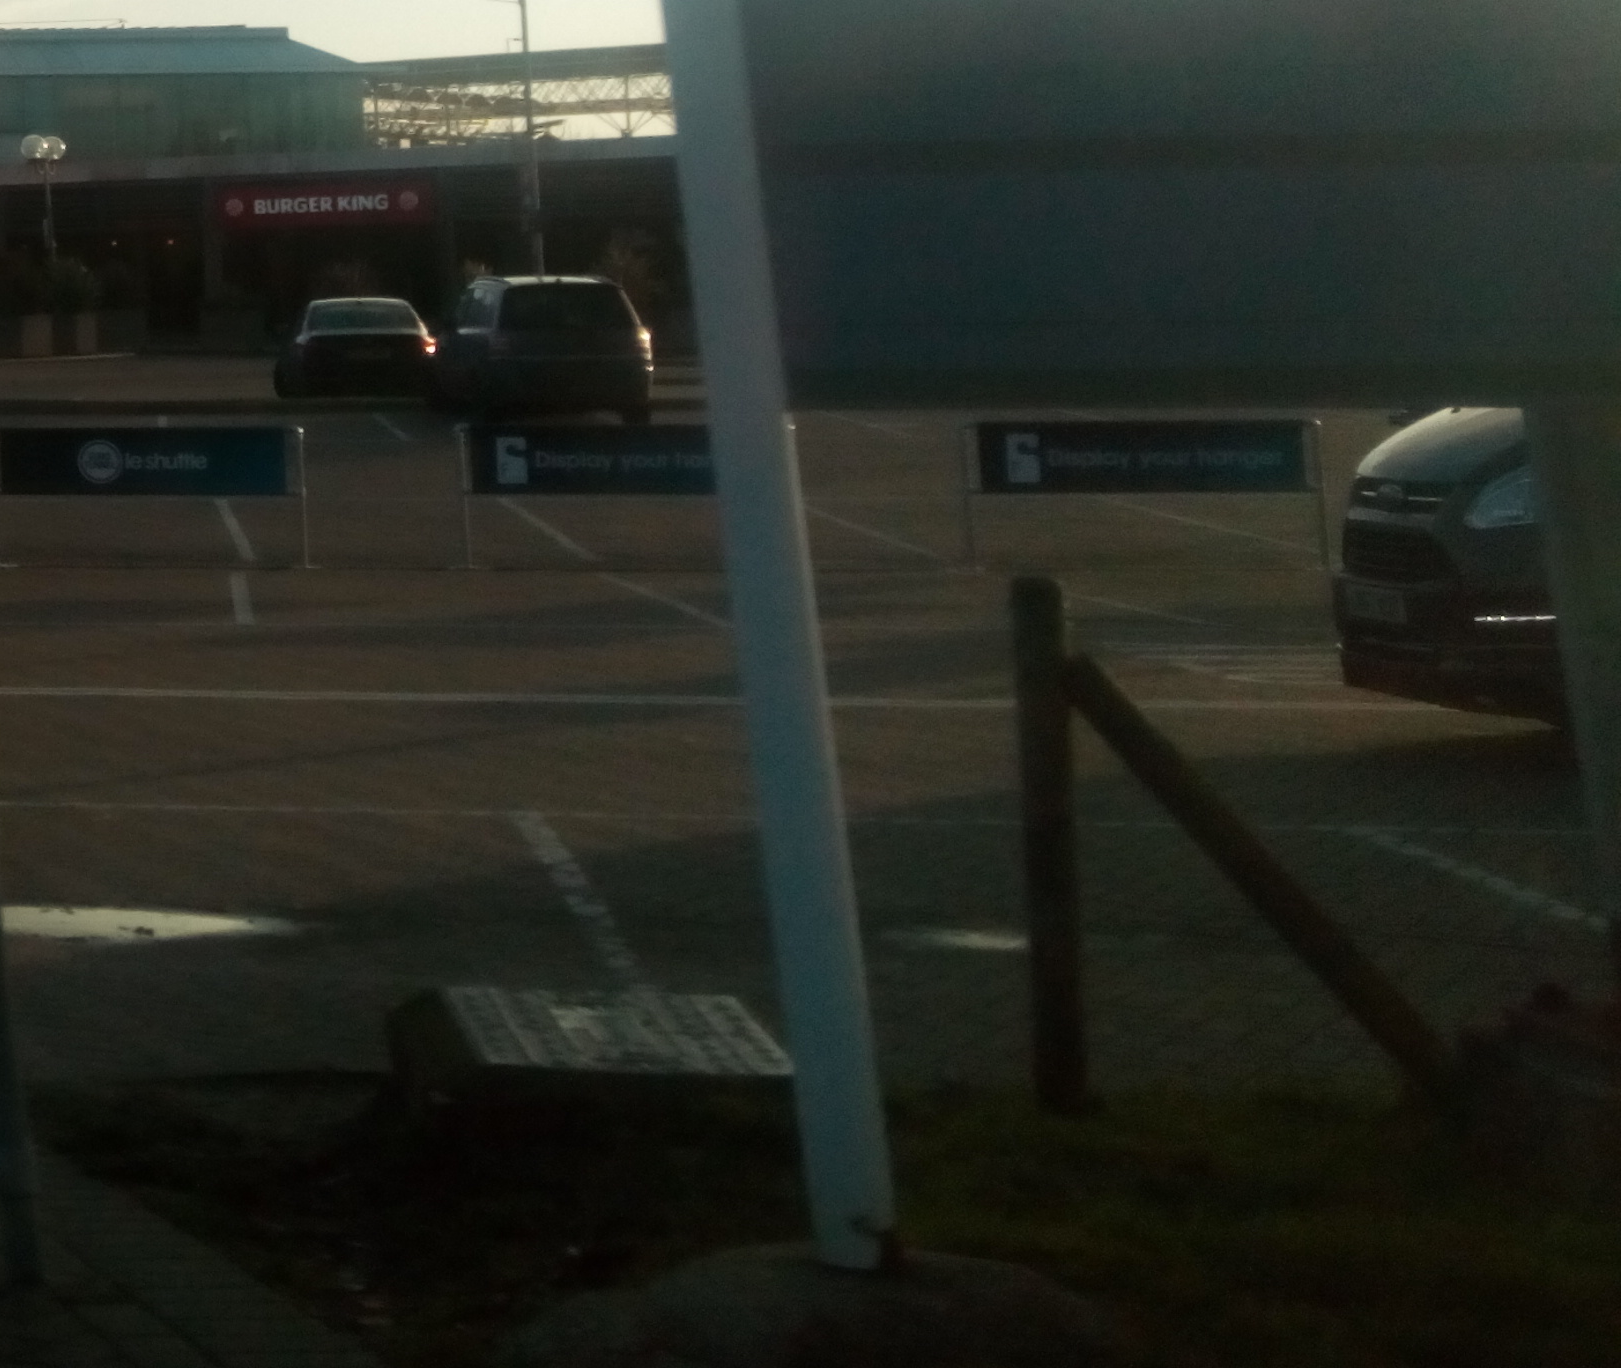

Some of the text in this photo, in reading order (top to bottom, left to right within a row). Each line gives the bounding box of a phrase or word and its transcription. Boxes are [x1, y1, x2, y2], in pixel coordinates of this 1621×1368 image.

[253, 194, 389, 214] BURGER KING
[124, 452, 144, 470] le
[145, 452, 208, 470] shuttle
[534, 450, 612, 473] Display
